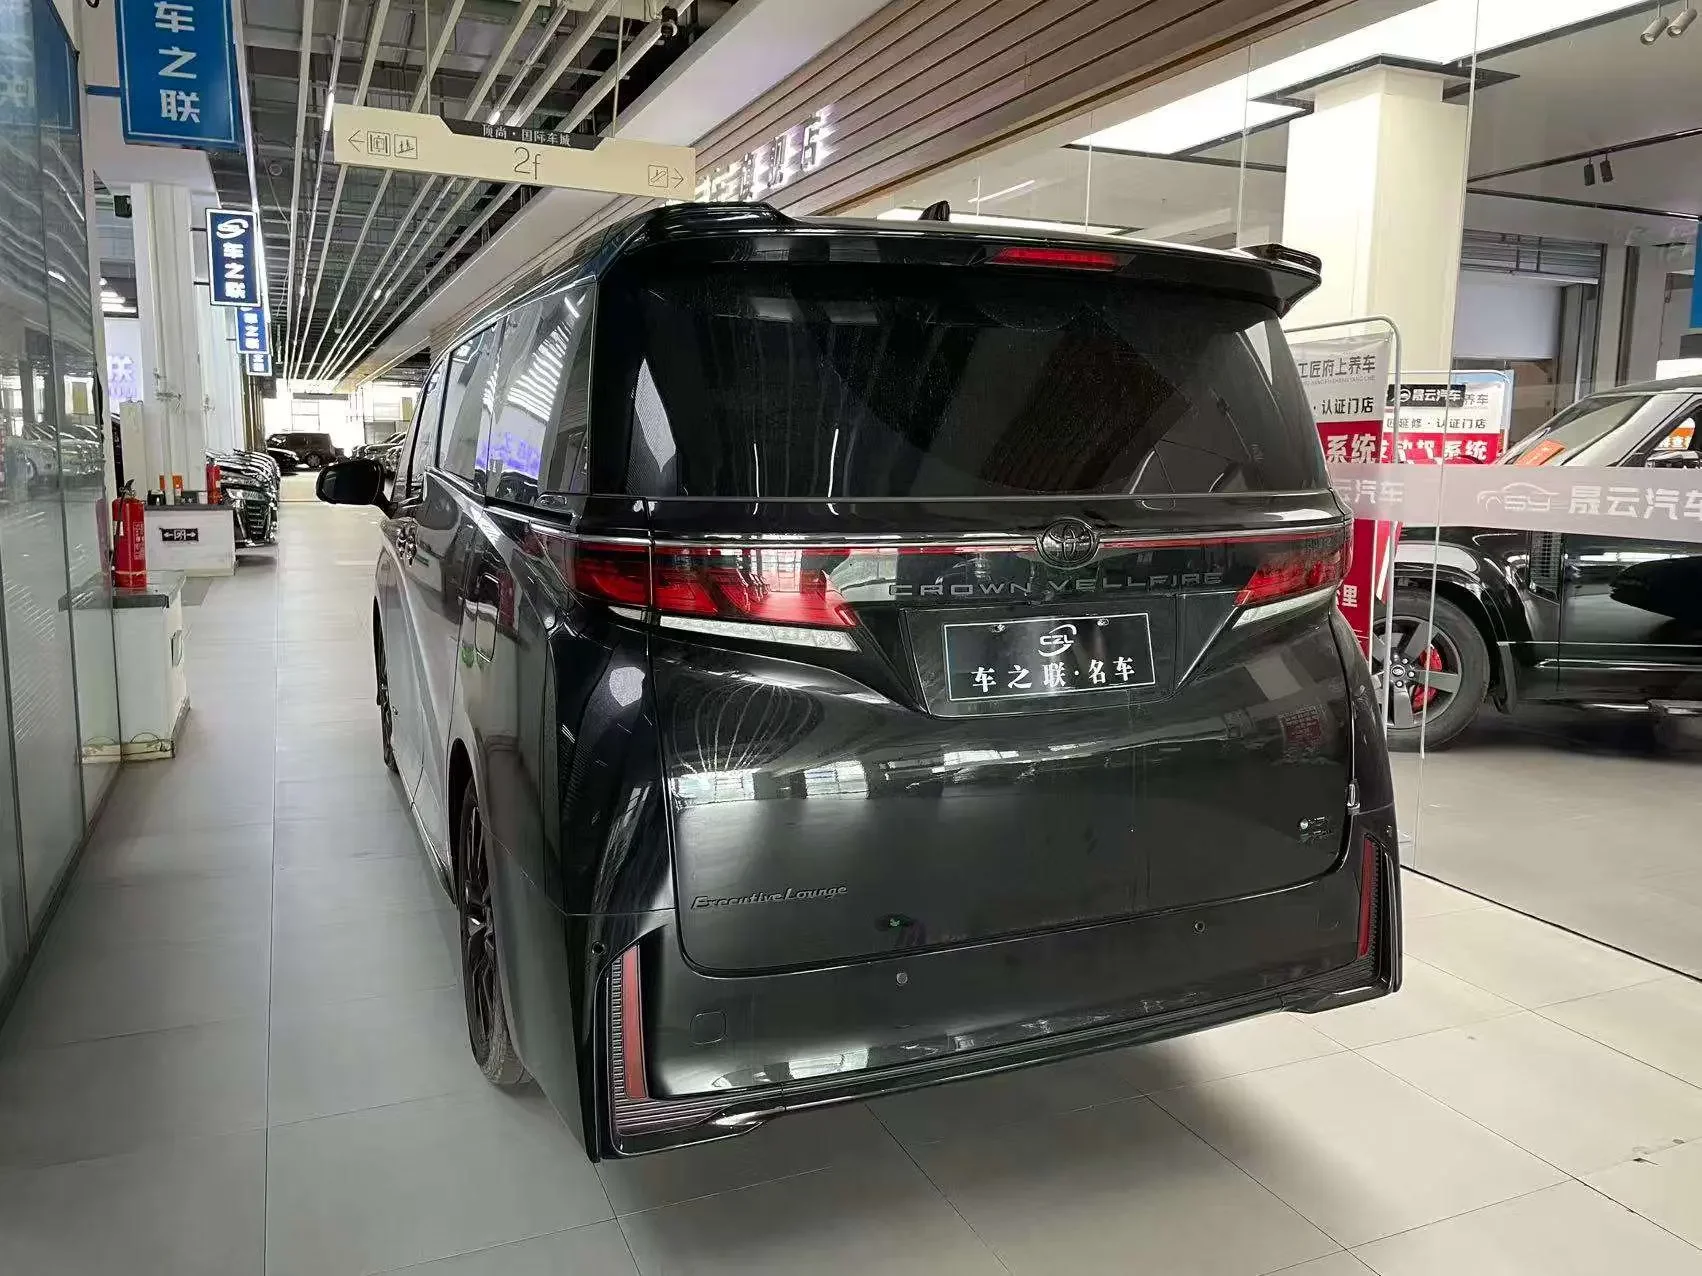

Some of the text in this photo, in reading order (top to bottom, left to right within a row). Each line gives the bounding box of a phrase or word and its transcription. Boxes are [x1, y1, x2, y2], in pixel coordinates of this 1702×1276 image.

[154, 1, 201, 124] 车之联
[514, 146, 541, 180] 2f
[888, 572, 1225, 597] CROWN VELLFIRE
